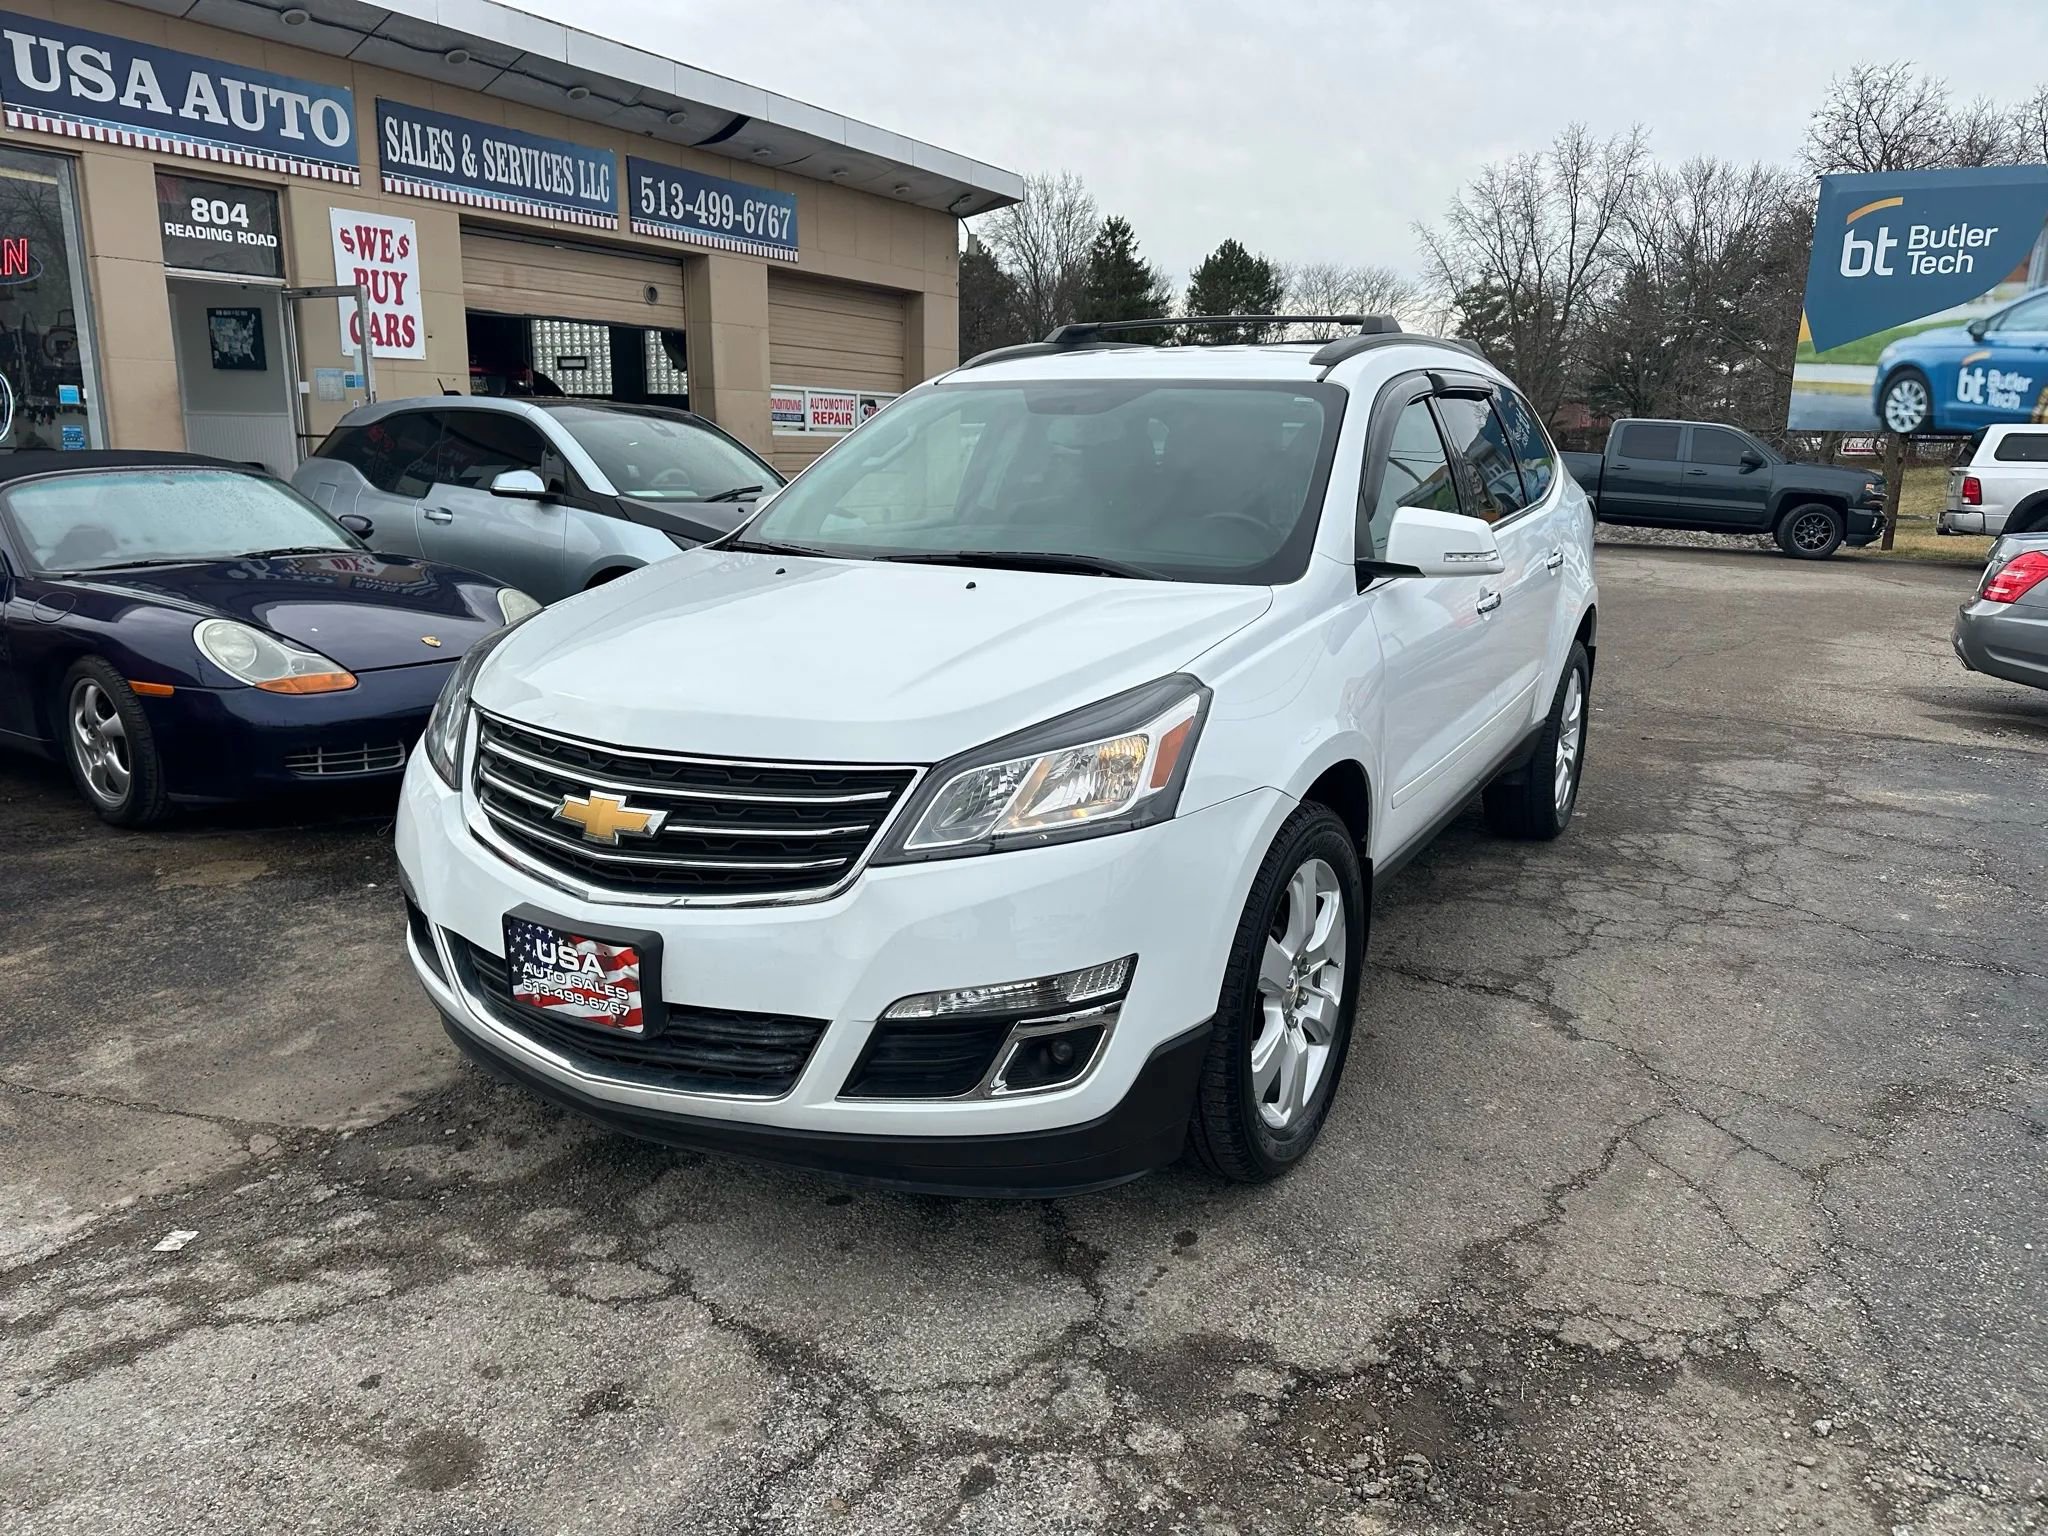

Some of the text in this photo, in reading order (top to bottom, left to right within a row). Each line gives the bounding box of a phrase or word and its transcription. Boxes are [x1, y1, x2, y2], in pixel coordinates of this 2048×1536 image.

[3, 29, 350, 147] USA AUTO
[385, 116, 610, 203] SALES & SERVICES LLC
[191, 197, 249, 228] 804
[640, 175, 791, 240] 513-499-6767
[164, 222, 278, 248] READING ROAD
[1840, 226, 1898, 277] bt
[1908, 223, 1999, 248] Butler
[1907, 250, 1974, 275] Tech
[353, 267, 408, 306] BUY
[810, 398, 854, 411] AUTOMOTIVE
[813, 411, 853, 426] REPAIR
[536, 938, 606, 979] USA
[522, 962, 628, 1001] AUTO SALES
